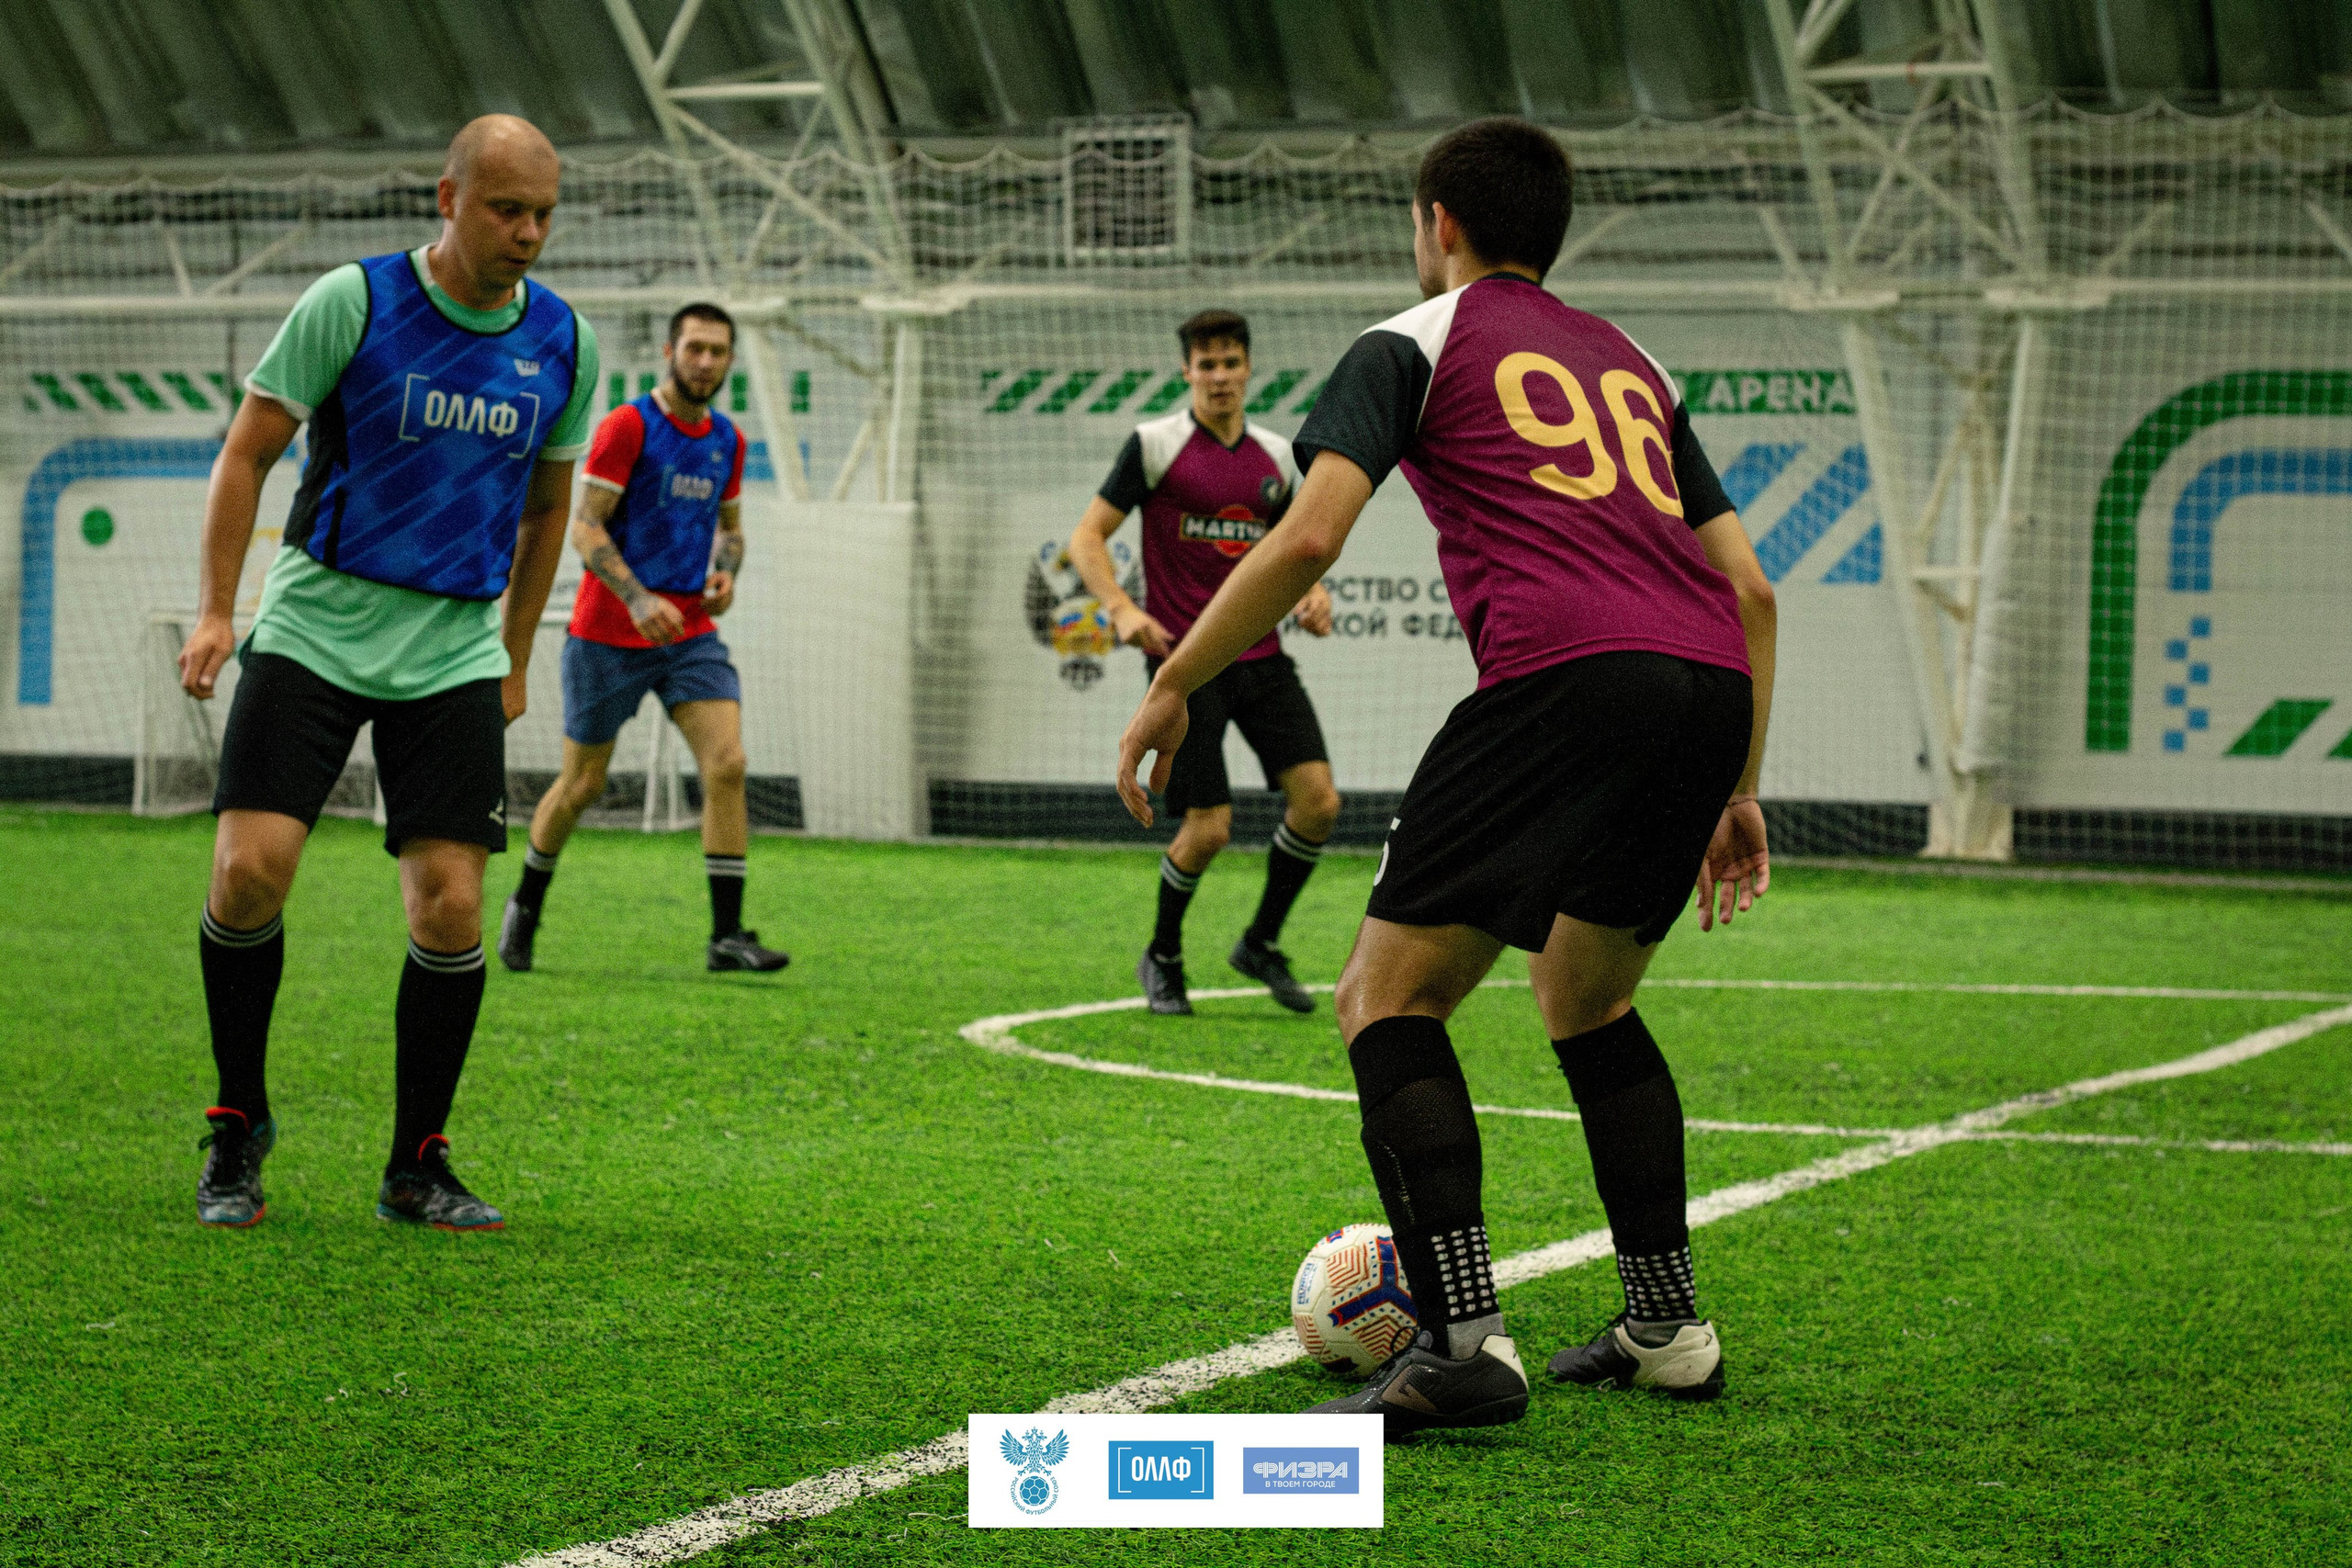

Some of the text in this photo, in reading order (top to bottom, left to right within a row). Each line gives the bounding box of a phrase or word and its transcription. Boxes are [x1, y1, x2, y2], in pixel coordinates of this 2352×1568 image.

[424, 389, 519, 439] ОЛЛФ
[1705, 375, 1854, 411] АРЕНА
[1494, 351, 1684, 519] 96
